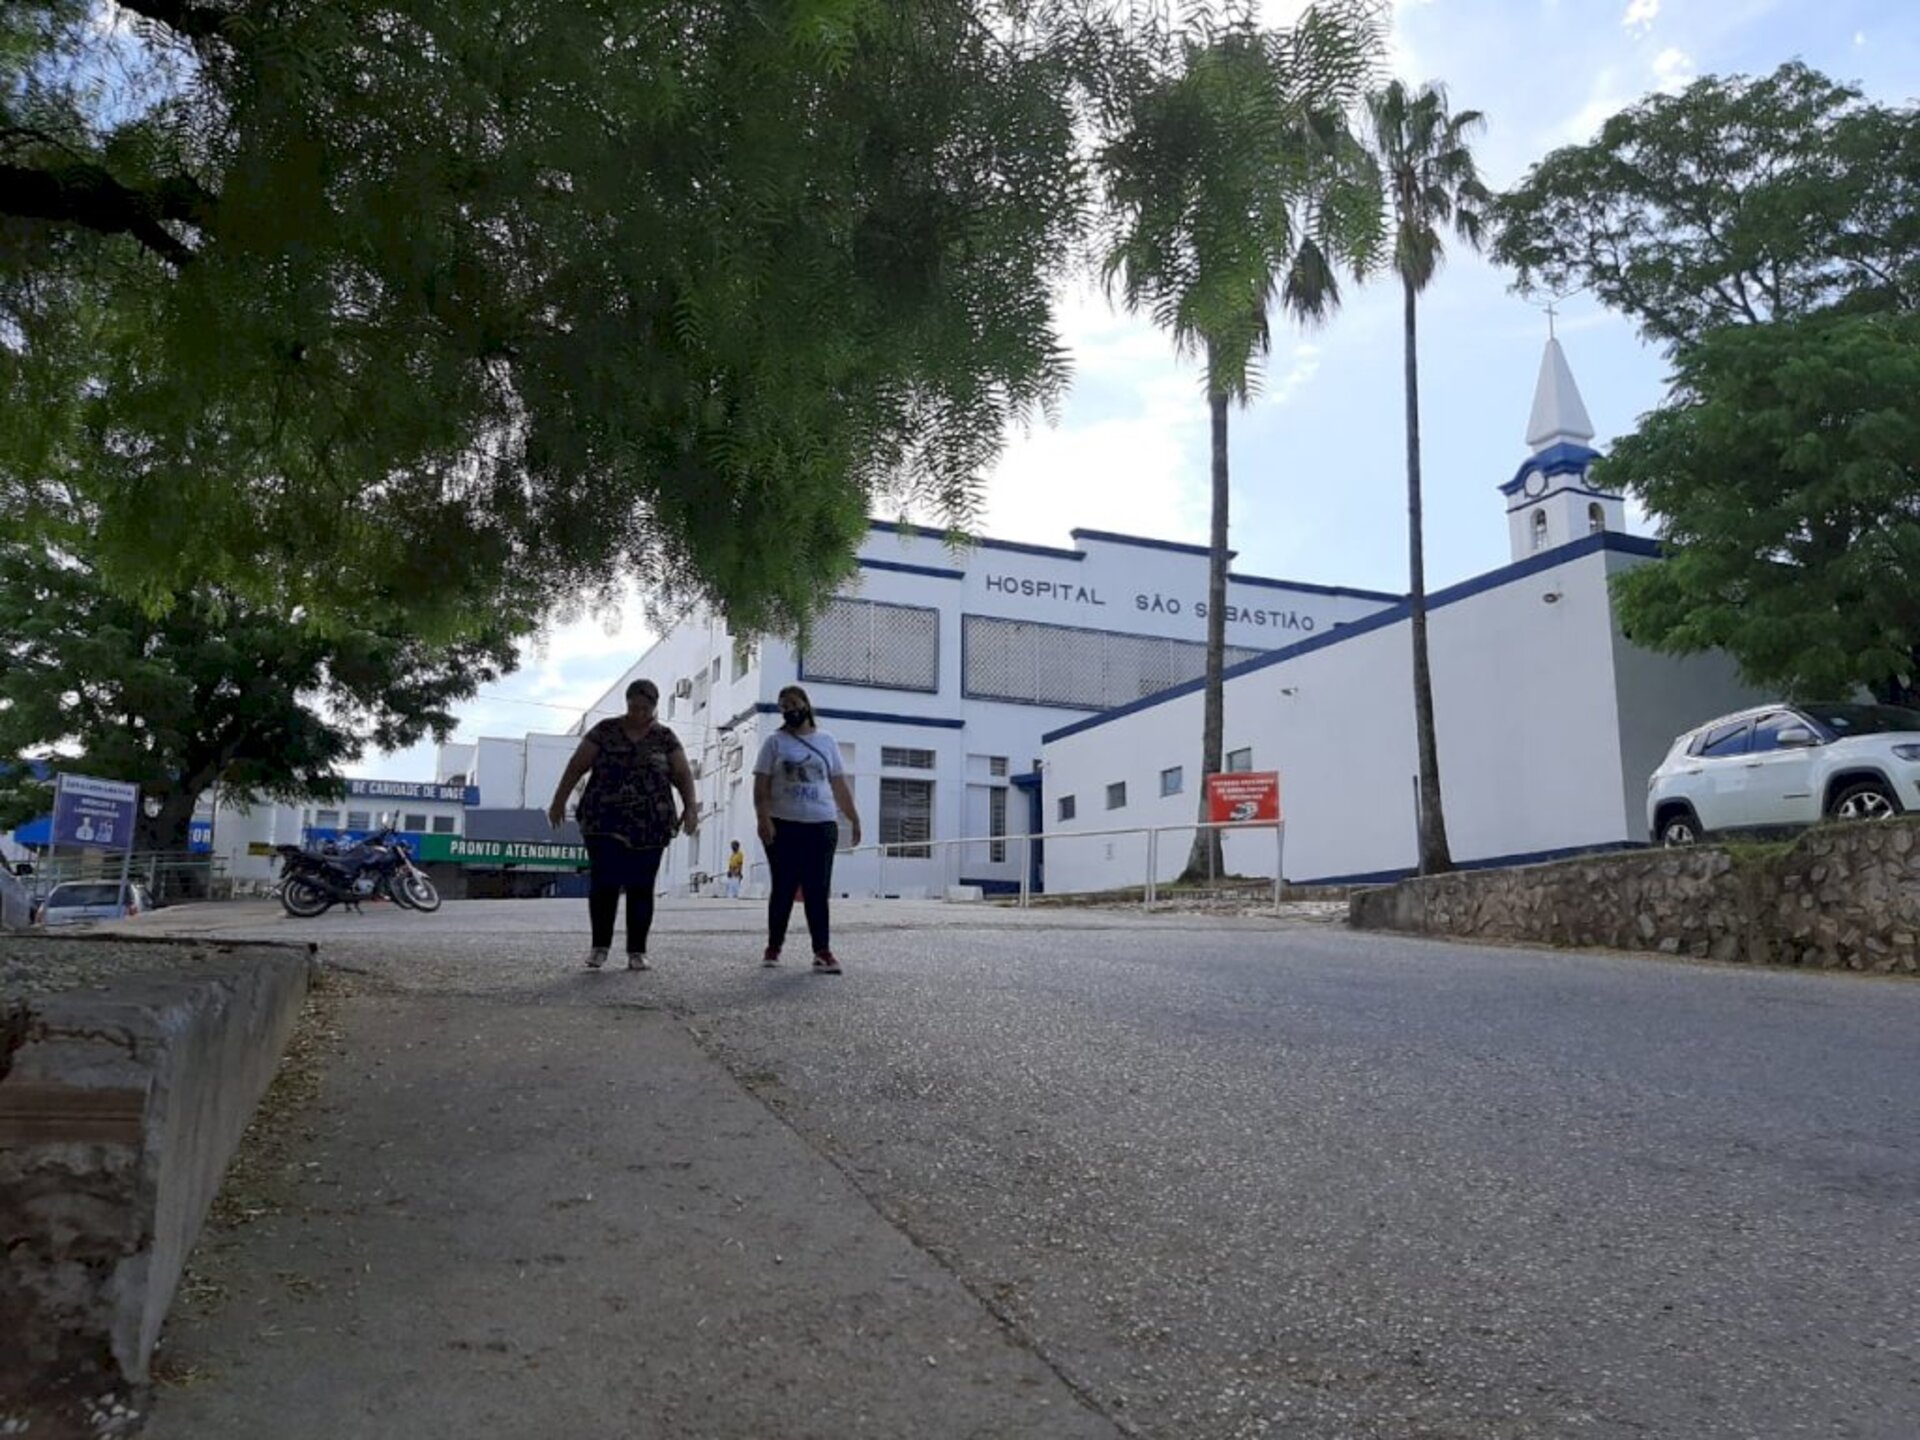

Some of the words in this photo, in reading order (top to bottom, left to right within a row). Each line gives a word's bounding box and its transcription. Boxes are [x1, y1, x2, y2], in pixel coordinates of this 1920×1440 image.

[986, 574, 1106, 605] HOSPITAL
[1135, 594, 1181, 616] SÃO
[1195, 603, 1315, 631] SBASTIÃO
[369, 782, 421, 797] CARIDADE
[450, 841, 501, 855] PRONTO
